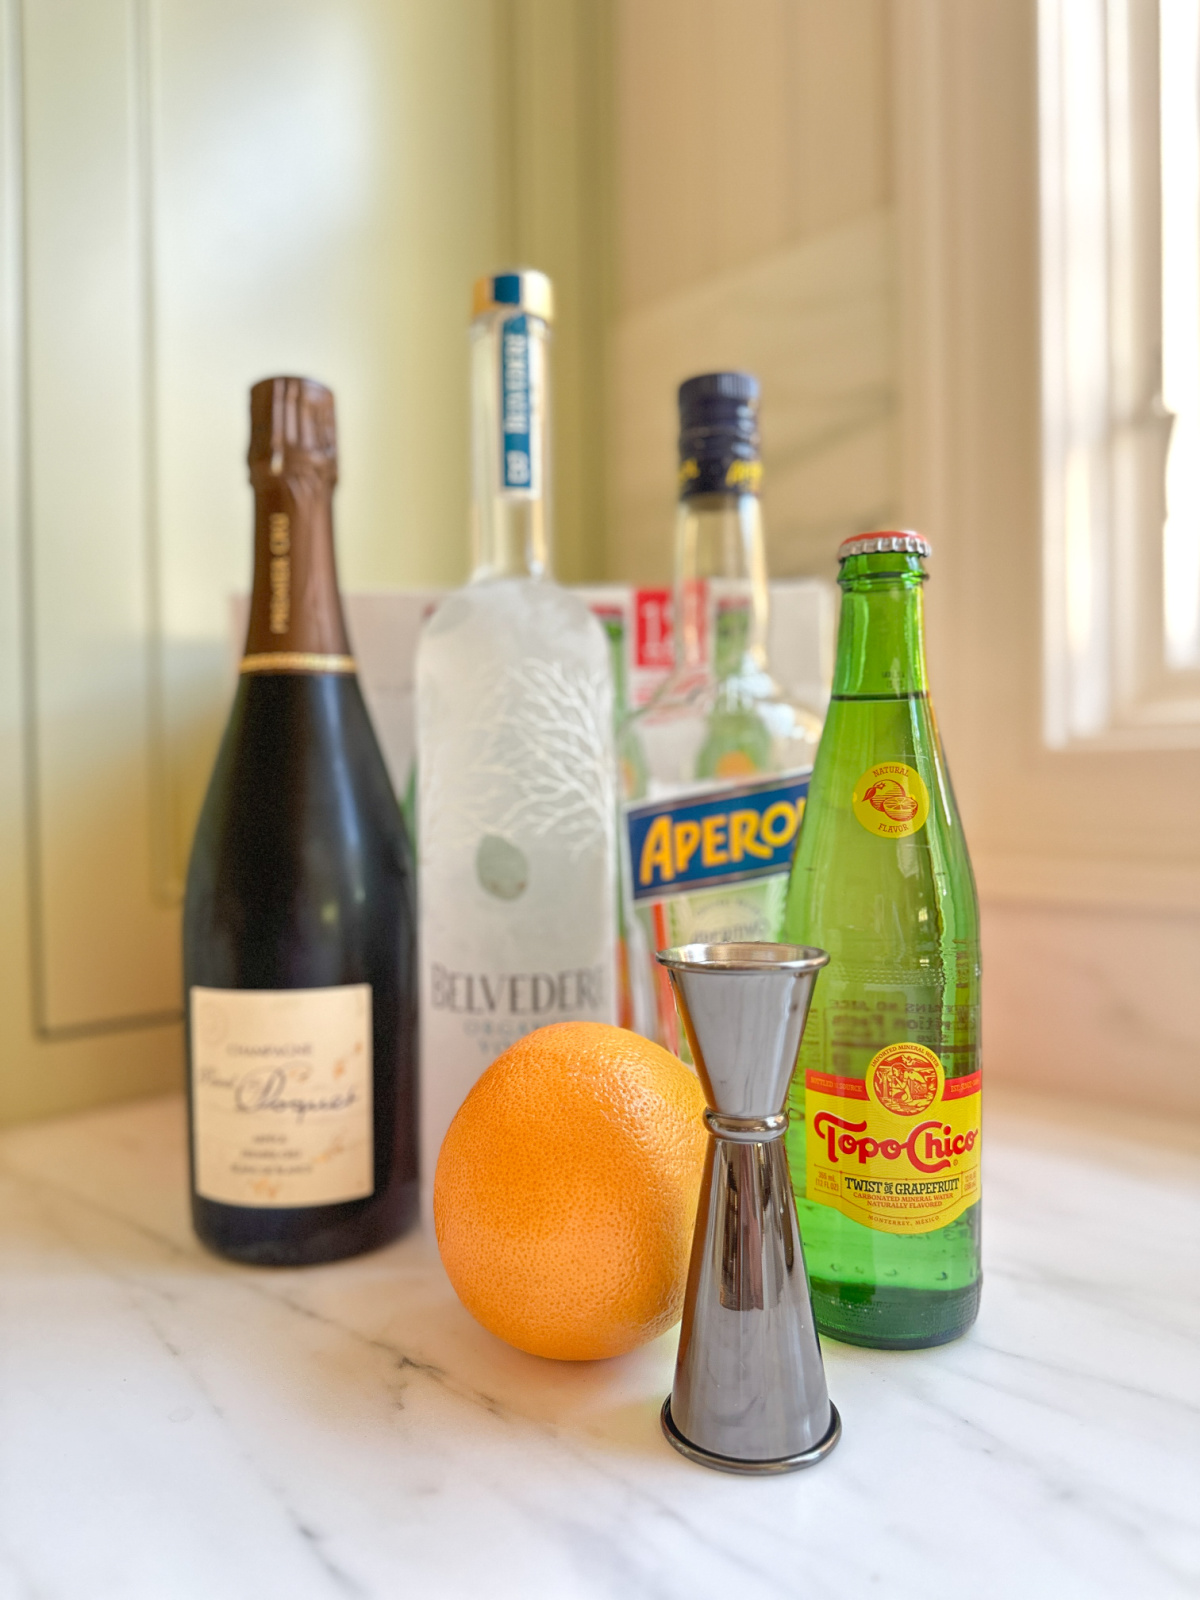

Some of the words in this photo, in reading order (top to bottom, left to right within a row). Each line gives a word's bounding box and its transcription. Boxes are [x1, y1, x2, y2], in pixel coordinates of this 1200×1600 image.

[872, 765, 909, 778] NATURAL
[877, 822, 909, 833] FLAVOR
[898, 1044, 925, 1053] MINERAL
[813, 1110, 902, 1166] Topo
[902, 1120, 979, 1174] Chico
[844, 1176, 883, 1193] TWIST
[895, 1177, 960, 1195] GRAPEFRUIT
[853, 1192, 900, 1202] CARBONATED
[901, 1195, 932, 1203] MINERAL
[933, 1192, 954, 1202] WATER
[867, 1200, 909, 1209] NATURALLY
[909, 1200, 943, 1209] FLAVORED
[867, 1214, 913, 1226] MONTERREY,
